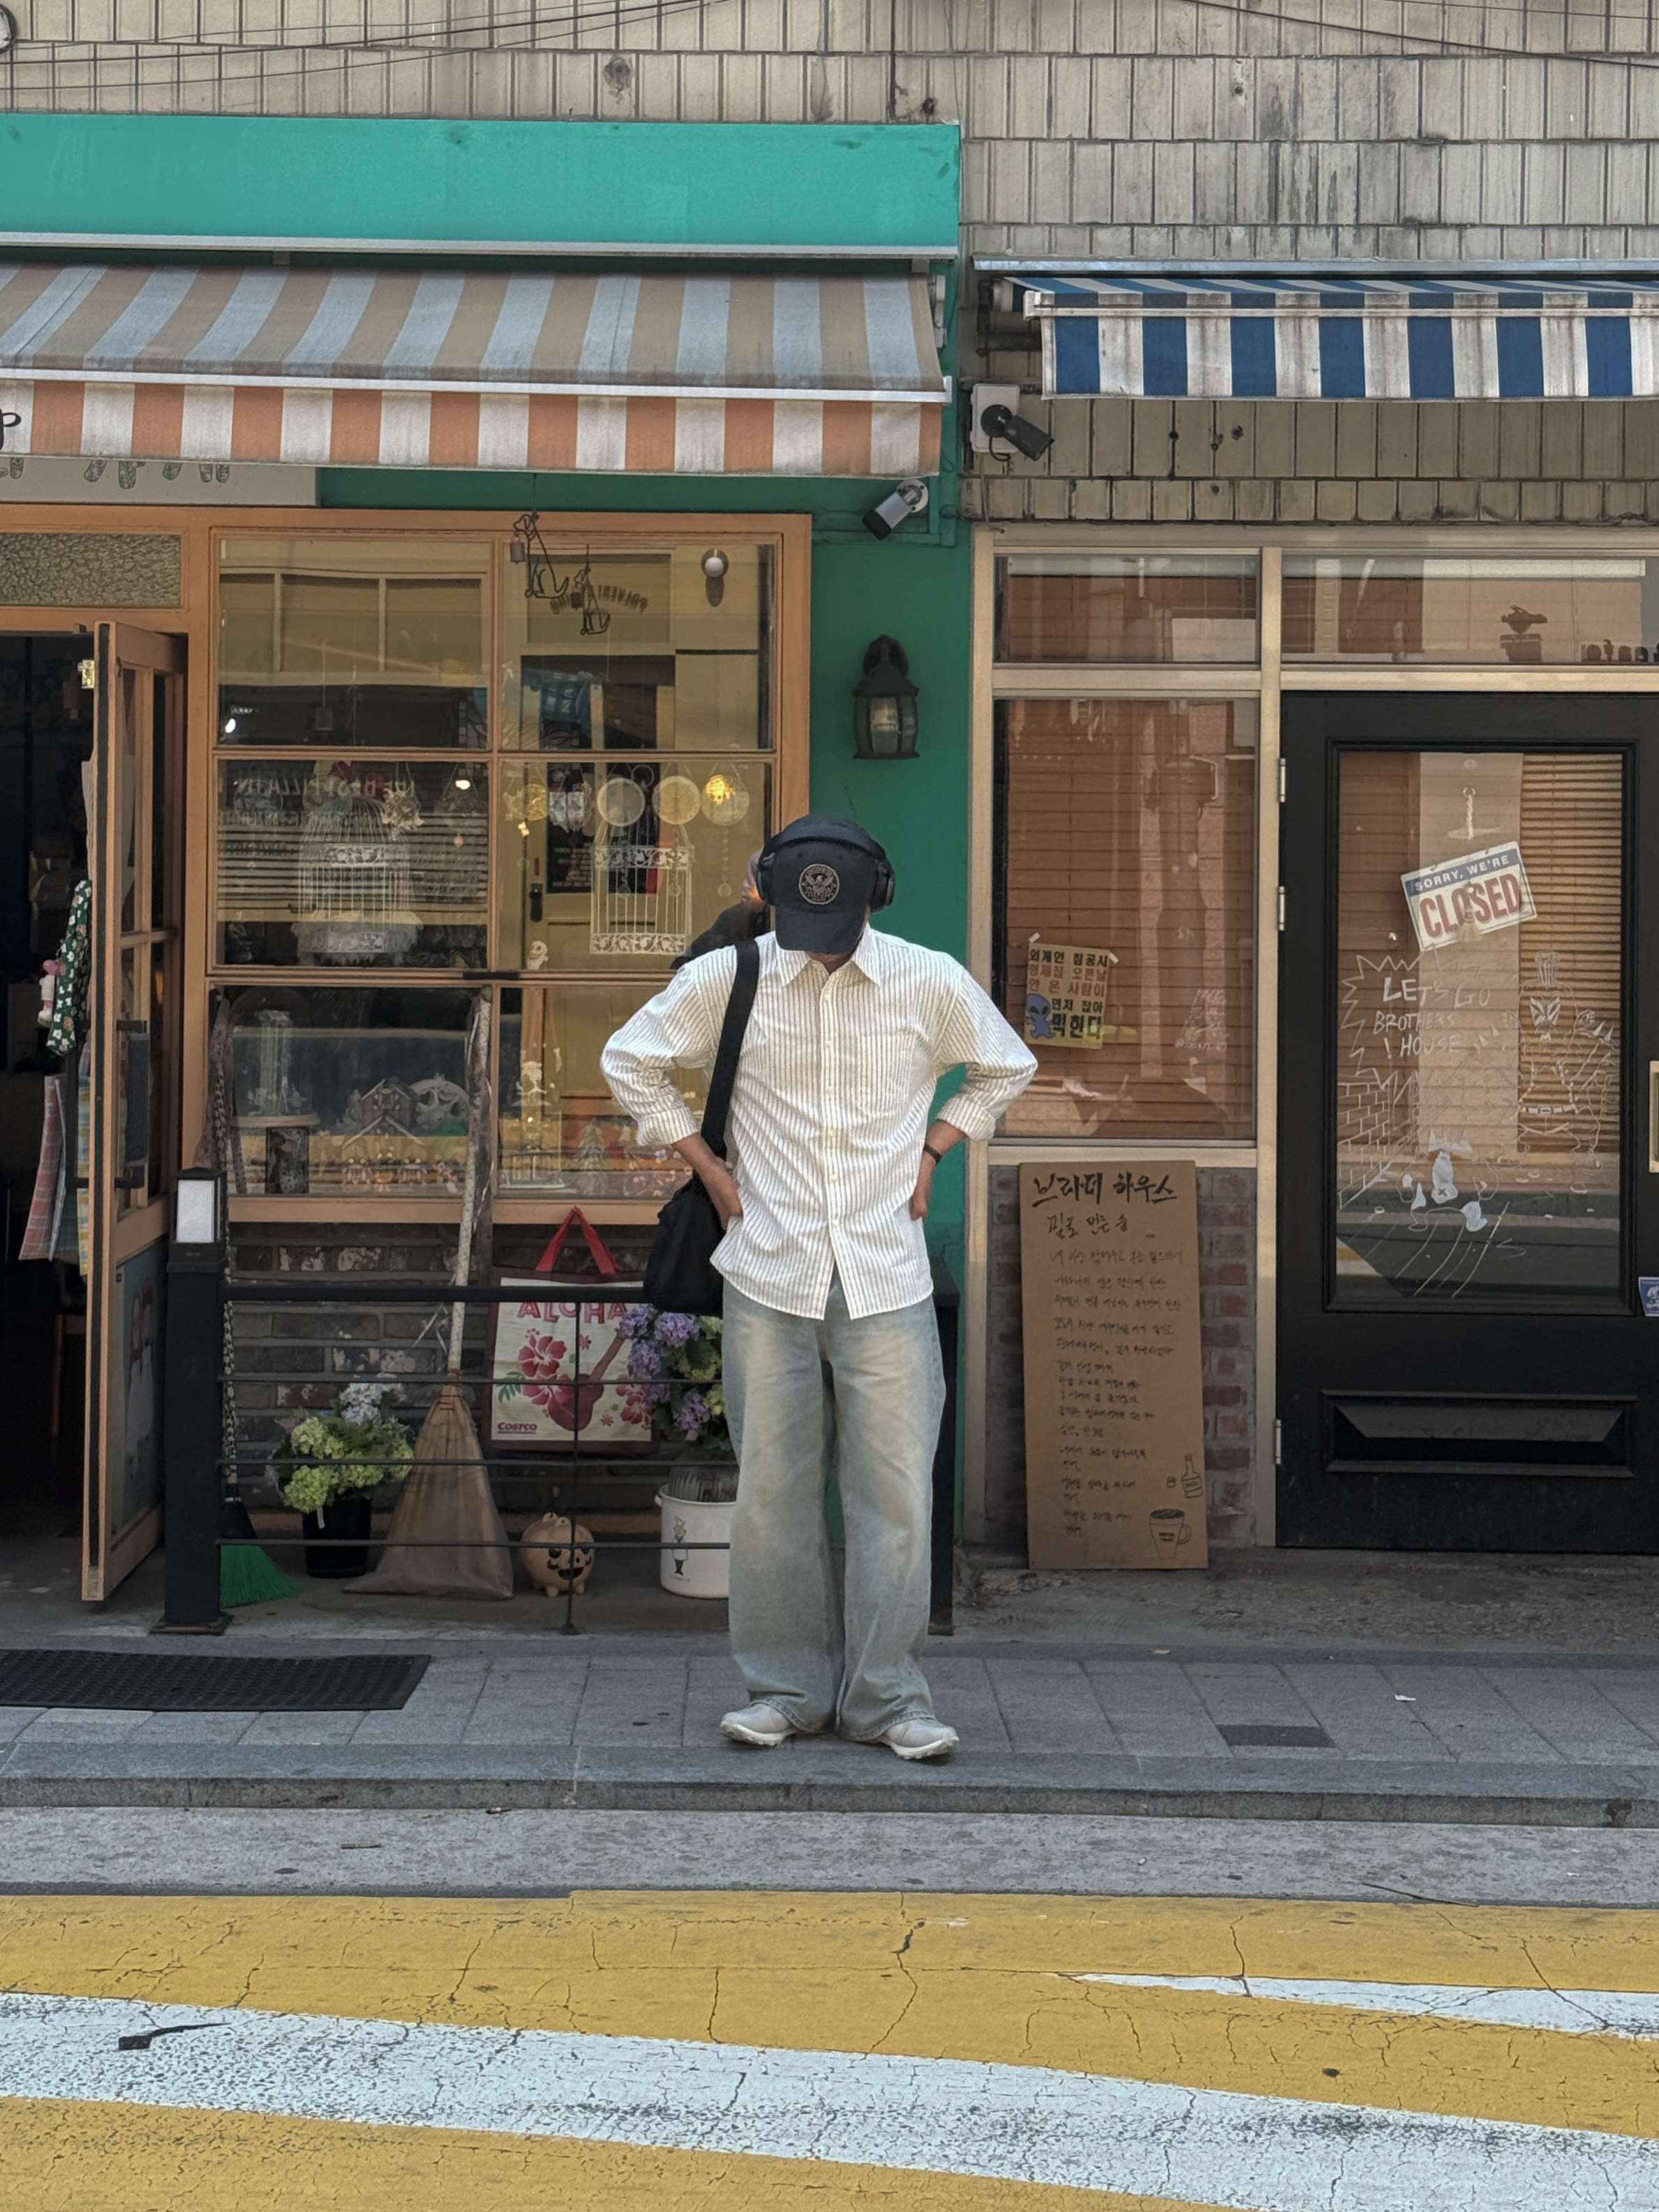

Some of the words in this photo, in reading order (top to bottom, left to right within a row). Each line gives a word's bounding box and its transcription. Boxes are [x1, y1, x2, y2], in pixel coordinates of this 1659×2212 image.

[1414, 870, 1464, 891] SORRY,
[1466, 854, 1510, 875] WE'RE
[1420, 873, 1523, 938] CLOSED
[1029, 949, 1064, 964] 외계인
[1073, 953, 1108, 967] 침공시
[1048, 979, 1060, 994] 온
[1066, 981, 1104, 997] 사람이
[1383, 977, 1449, 1007] LET'S
[1454, 983, 1491, 1009] GO
[1399, 1034, 1462, 1057] HOUSE
[1113, 1171, 1177, 1203] 하우스
